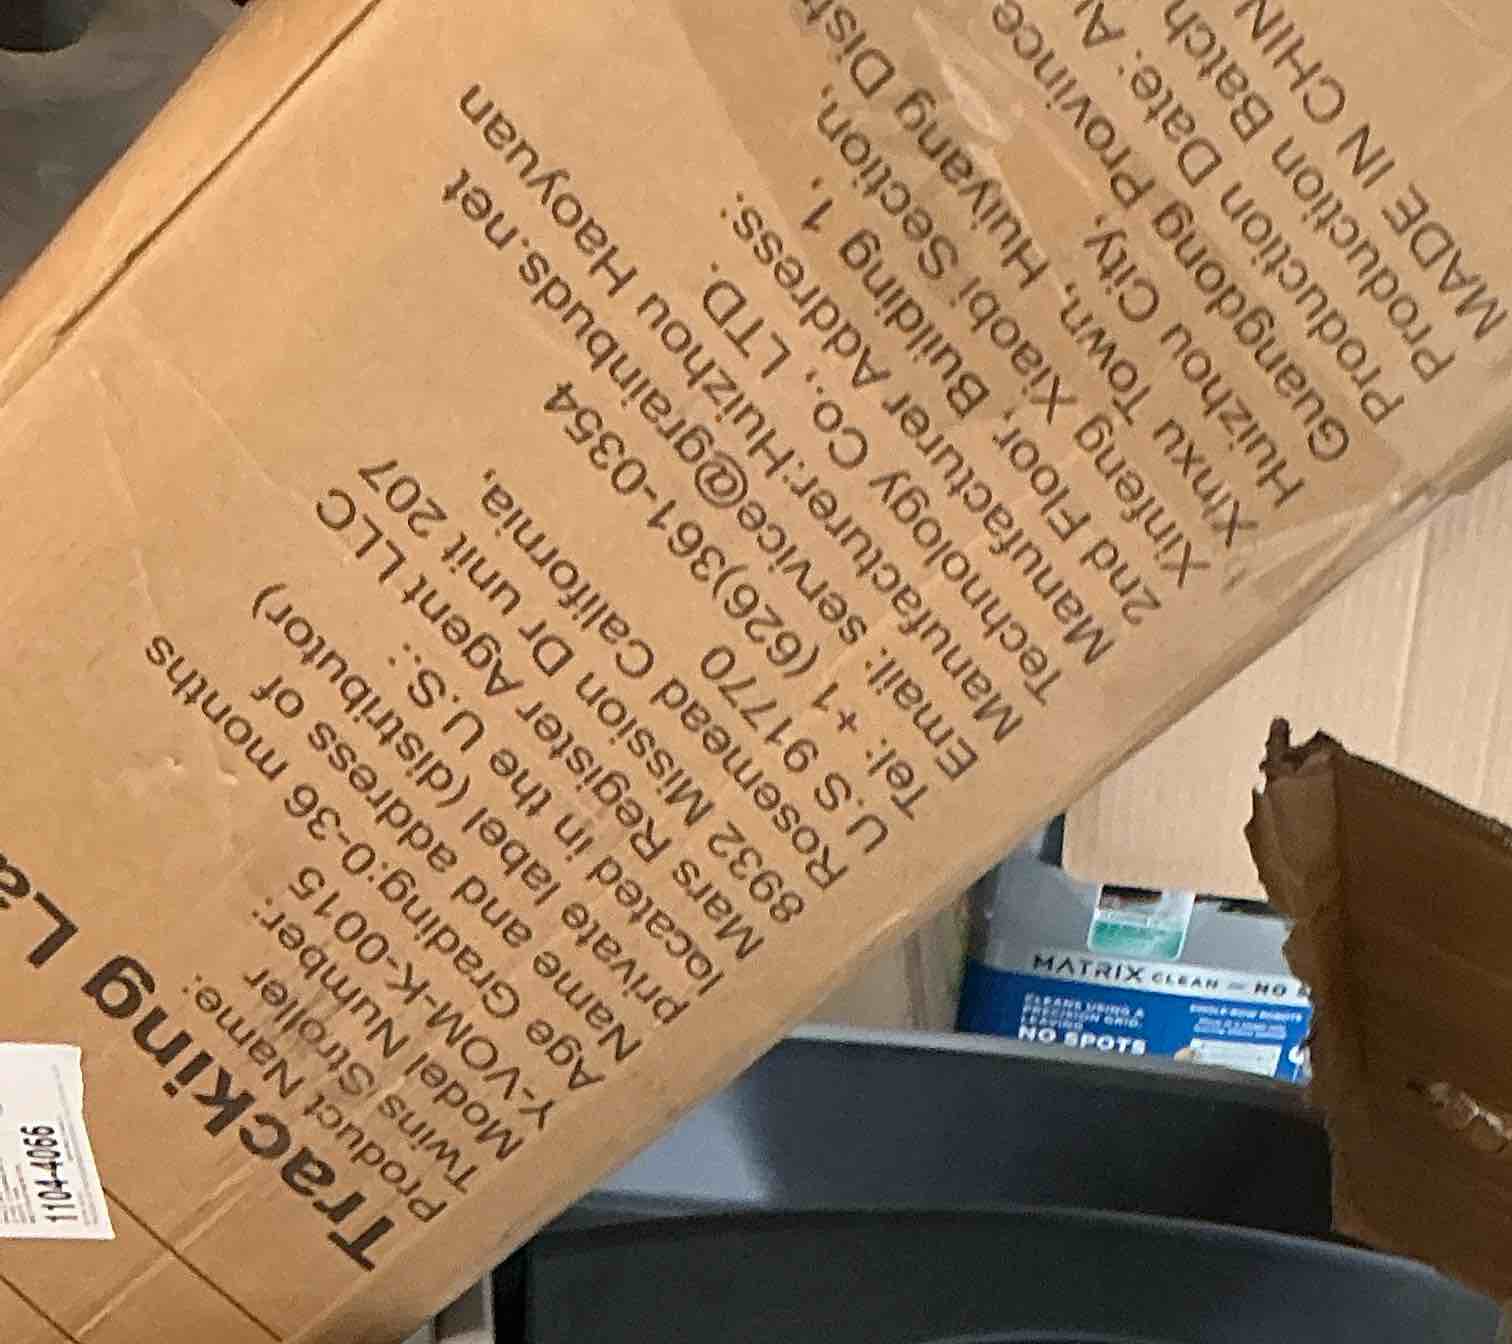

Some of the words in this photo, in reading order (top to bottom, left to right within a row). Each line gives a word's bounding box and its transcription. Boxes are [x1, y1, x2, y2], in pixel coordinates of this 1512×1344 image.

[1072, 1, 1126, 49] A
[1163, 1, 1275, 144] Batch
[1232, 1, 1346, 124] CHIN
[991, 1, 1156, 211] Province
[1116, 47, 1223, 188] Date:
[1335, 121, 1395, 190] IN
[458, 82, 638, 298] Haoyuan
[799, 175, 833, 234] 1,
[815, 82, 959, 281] Section,
[893, 86, 1051, 291] Huiyang
[701, 260, 792, 379] LTD.
[718, 190, 892, 389] Address:
[837, 227, 990, 421] Building
[1082, 213, 1160, 323] City,
[1219, 180, 1405, 425] Production
[1270, 134, 1456, 385] Production
[1380, 181, 1508, 342] MADE
[948, 275, 1078, 426] Xiaobi
[1058, 280, 1151, 427] Town,
[1150, 198, 1350, 463] Guangdong
[440, 166, 868, 646] service@grainbuds.net
[804, 368, 869, 470] Co.,
[1158, 321, 1305, 509] Huizhou
[314, 486, 407, 585] LLC
[356, 458, 448, 539] 207
[542, 380, 820, 679] (626)361-0354
[635, 291, 1024, 744] Manufacturer:Huizhou
[880, 391, 1115, 667] Manufacturer
[990, 406, 1092, 543] Floor,
[1072, 411, 1211, 590] Xinfeng
[1151, 417, 1259, 550] Xinxu
[399, 572, 524, 698] Agent
[439, 530, 521, 617] unit
[480, 467, 655, 679] California,
[867, 468, 1062, 707] Technology
[1078, 536, 1162, 626] 2nd
[144, 634, 289, 782] months
[247, 673, 305, 719] of
[251, 581, 471, 809] (distributor)
[386, 641, 485, 755] U.S.:
[516, 618, 575, 679] Dr
[699, 643, 820, 774] 91770
[809, 679, 858, 734] +1
[863, 645, 979, 782] Email:
[306, 718, 458, 873] address
[488, 746, 552, 818] the
[514, 699, 673, 864] Register
[574, 670, 716, 830] Mission
[647, 675, 849, 892] Rosemead
[812, 771, 889, 857] U.S
[864, 735, 929, 822] Tel:
[282, 782, 520, 1020] Grading:0-36
[460, 805, 562, 907] label
[552, 811, 595, 862] in
[706, 819, 805, 925] 8932
[448, 874, 533, 949] and
[560, 900, 691, 1025] private
[583, 853, 725, 997] located
[671, 857, 765, 962] Mars
[1033, 953, 1146, 983] MATRIX
[1151, 973, 1219, 991] CLEAN
[1254, 980, 1288, 998] NO
[180, 972, 307, 1100] Name:
[241, 967, 378, 1099] Stroller
[250, 895, 410, 1059] Number:
[286, 865, 557, 1131] Y-VOM-K-0015
[532, 950, 643, 1065] Name
[1018, 1025, 1057, 1043] NO
[1063, 1031, 1147, 1056] SPOTS
[1086, 999, 1131, 1016] USING
[1134, 1006, 1146, 1020] A
[79, 954, 395, 1272] Tracking
[401, 1051, 524, 1162] Model
[524, 1017, 606, 1092] Age
[20, 1126, 78, 1222] 1104-4066
[301, 1090, 448, 1223] Product
[376, 1093, 479, 1195] Twins
